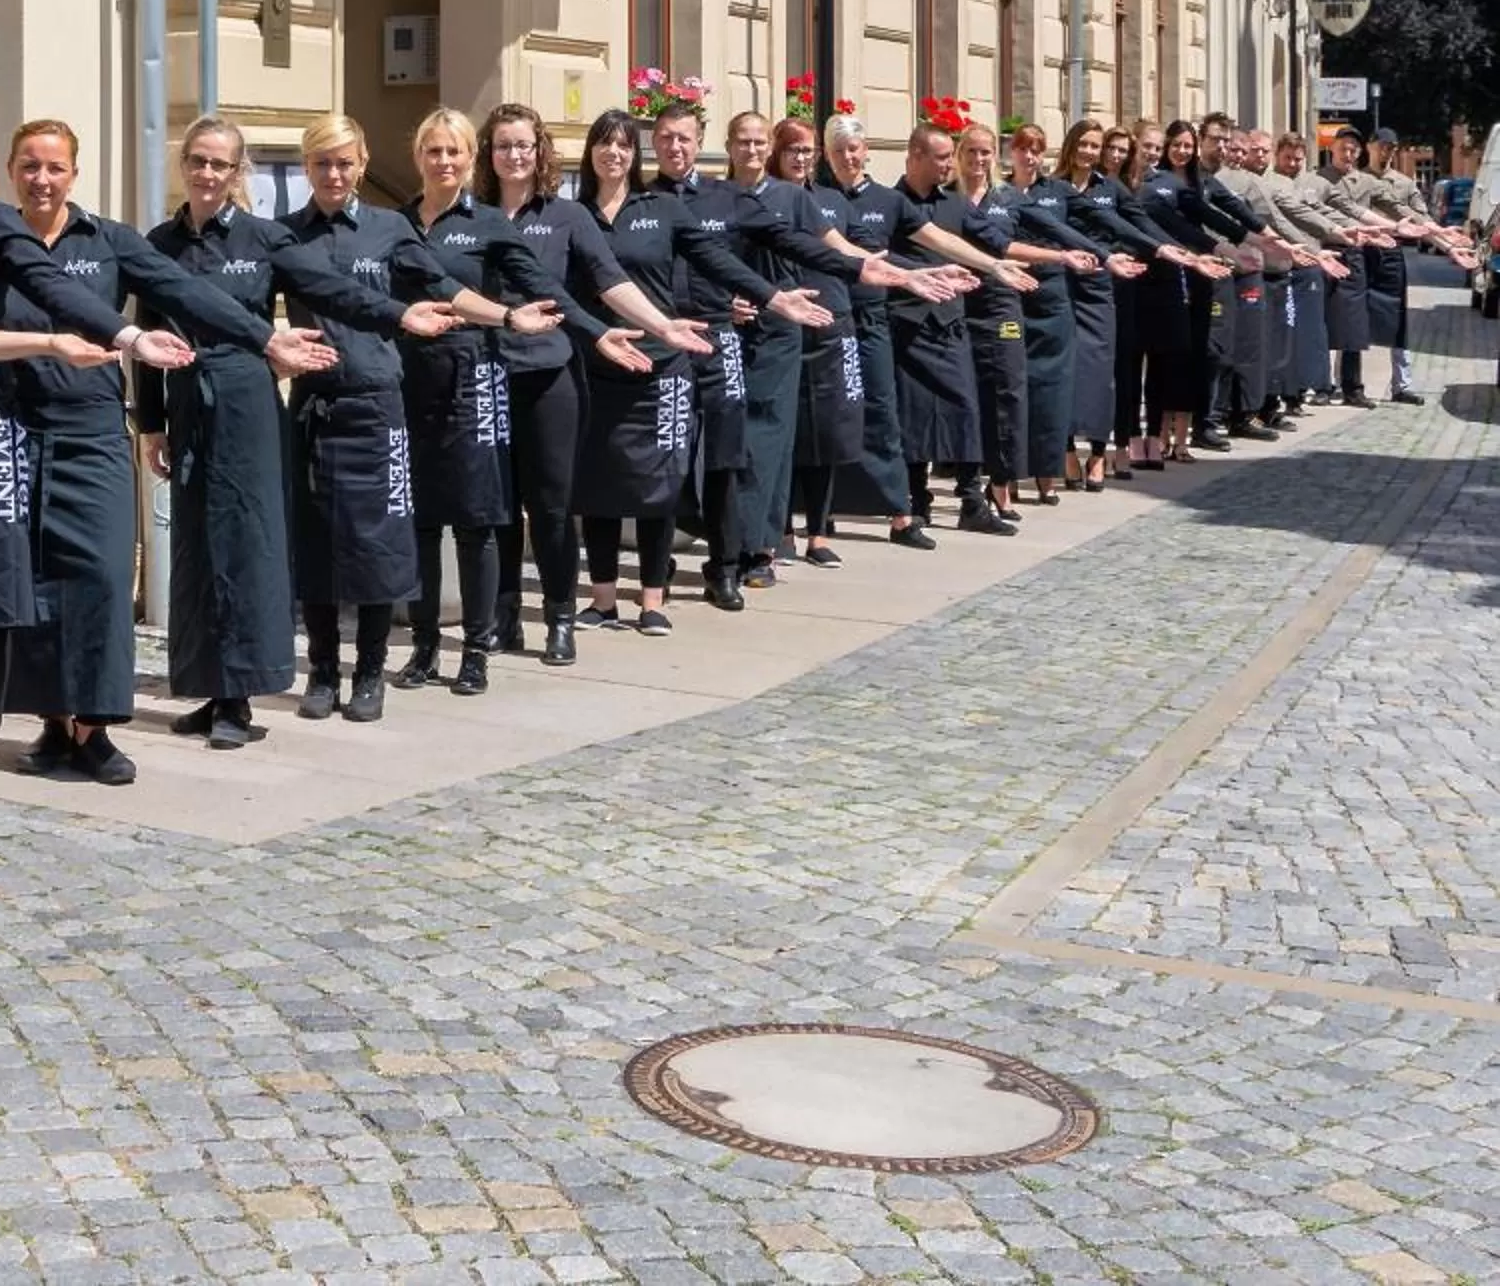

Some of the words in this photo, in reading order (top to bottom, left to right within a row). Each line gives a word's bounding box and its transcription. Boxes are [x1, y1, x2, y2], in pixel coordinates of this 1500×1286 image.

[720, 331, 741, 400] EVENT
[476, 362, 495, 447] EVENT
[657, 377, 675, 451] EVENT
[676, 375, 692, 449] Adler
[387, 427, 407, 517] EVENT
